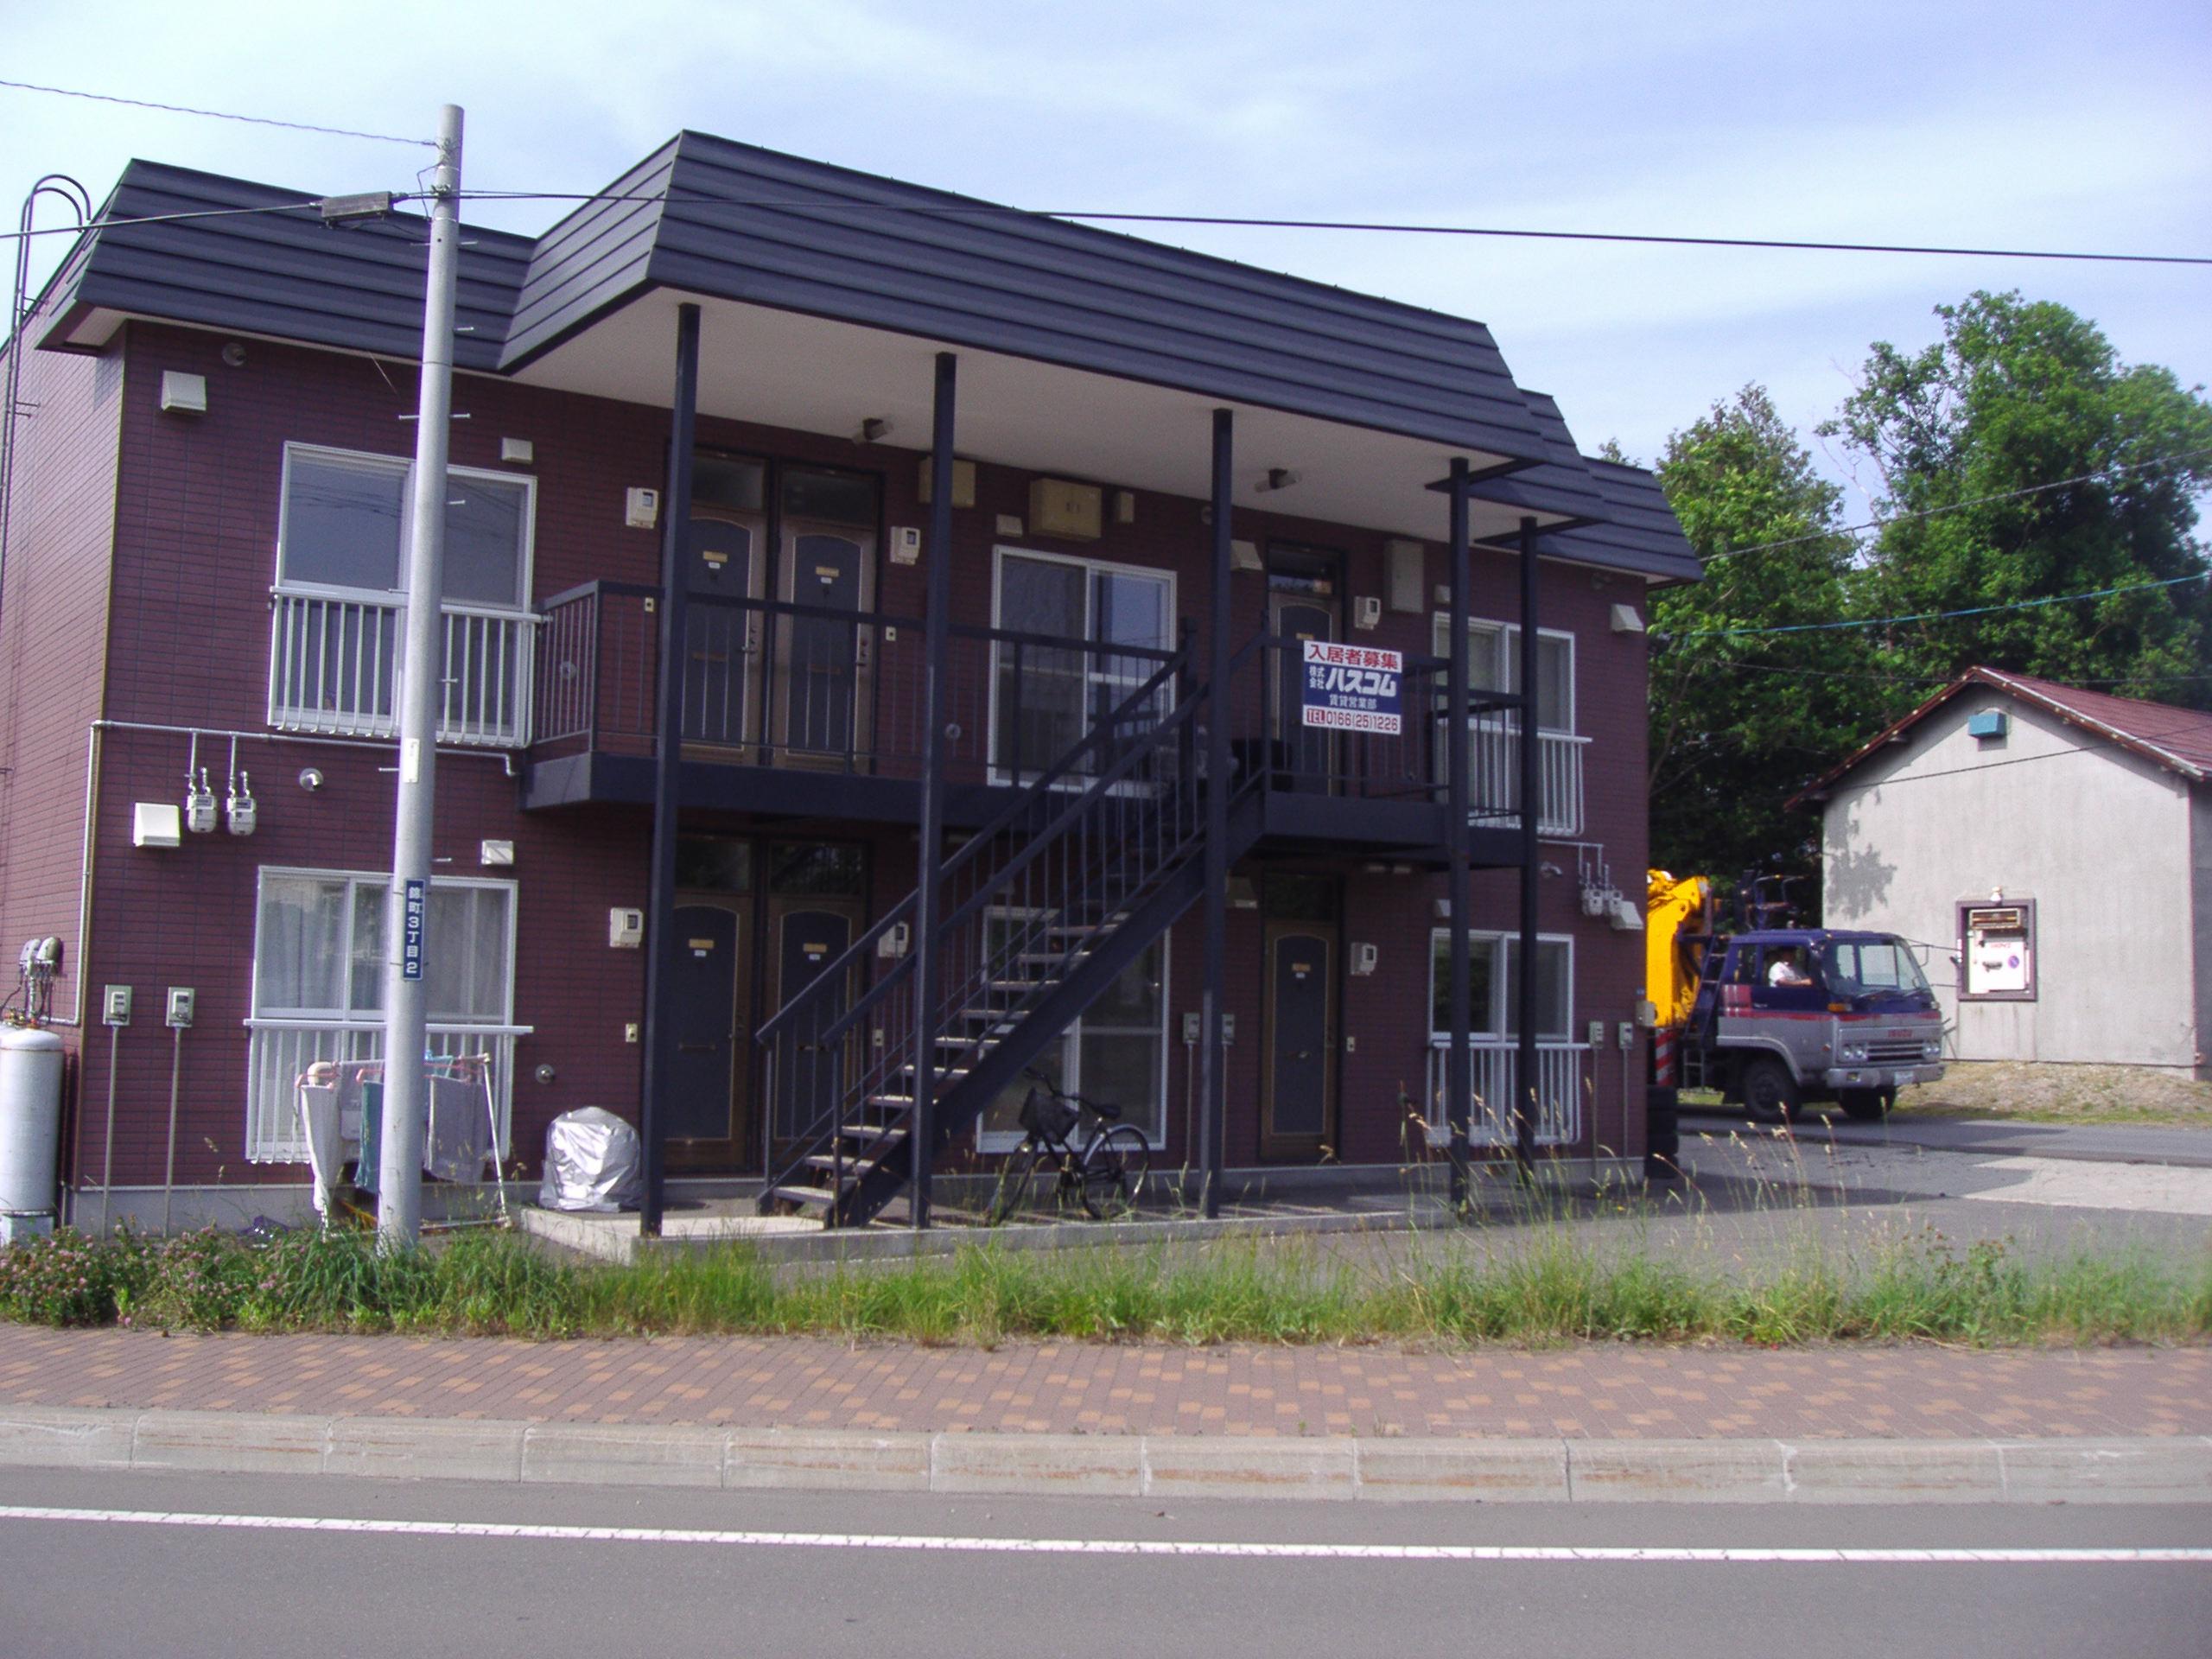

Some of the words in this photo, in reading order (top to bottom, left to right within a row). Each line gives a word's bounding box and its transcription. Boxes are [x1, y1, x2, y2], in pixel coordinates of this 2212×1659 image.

[1309, 644, 1397, 670] 入居者募集
[1325, 667, 1396, 697] ハスコム
[1307, 709, 1325, 724] TEL
[1326, 710, 1398, 731] 0166(25)1226
